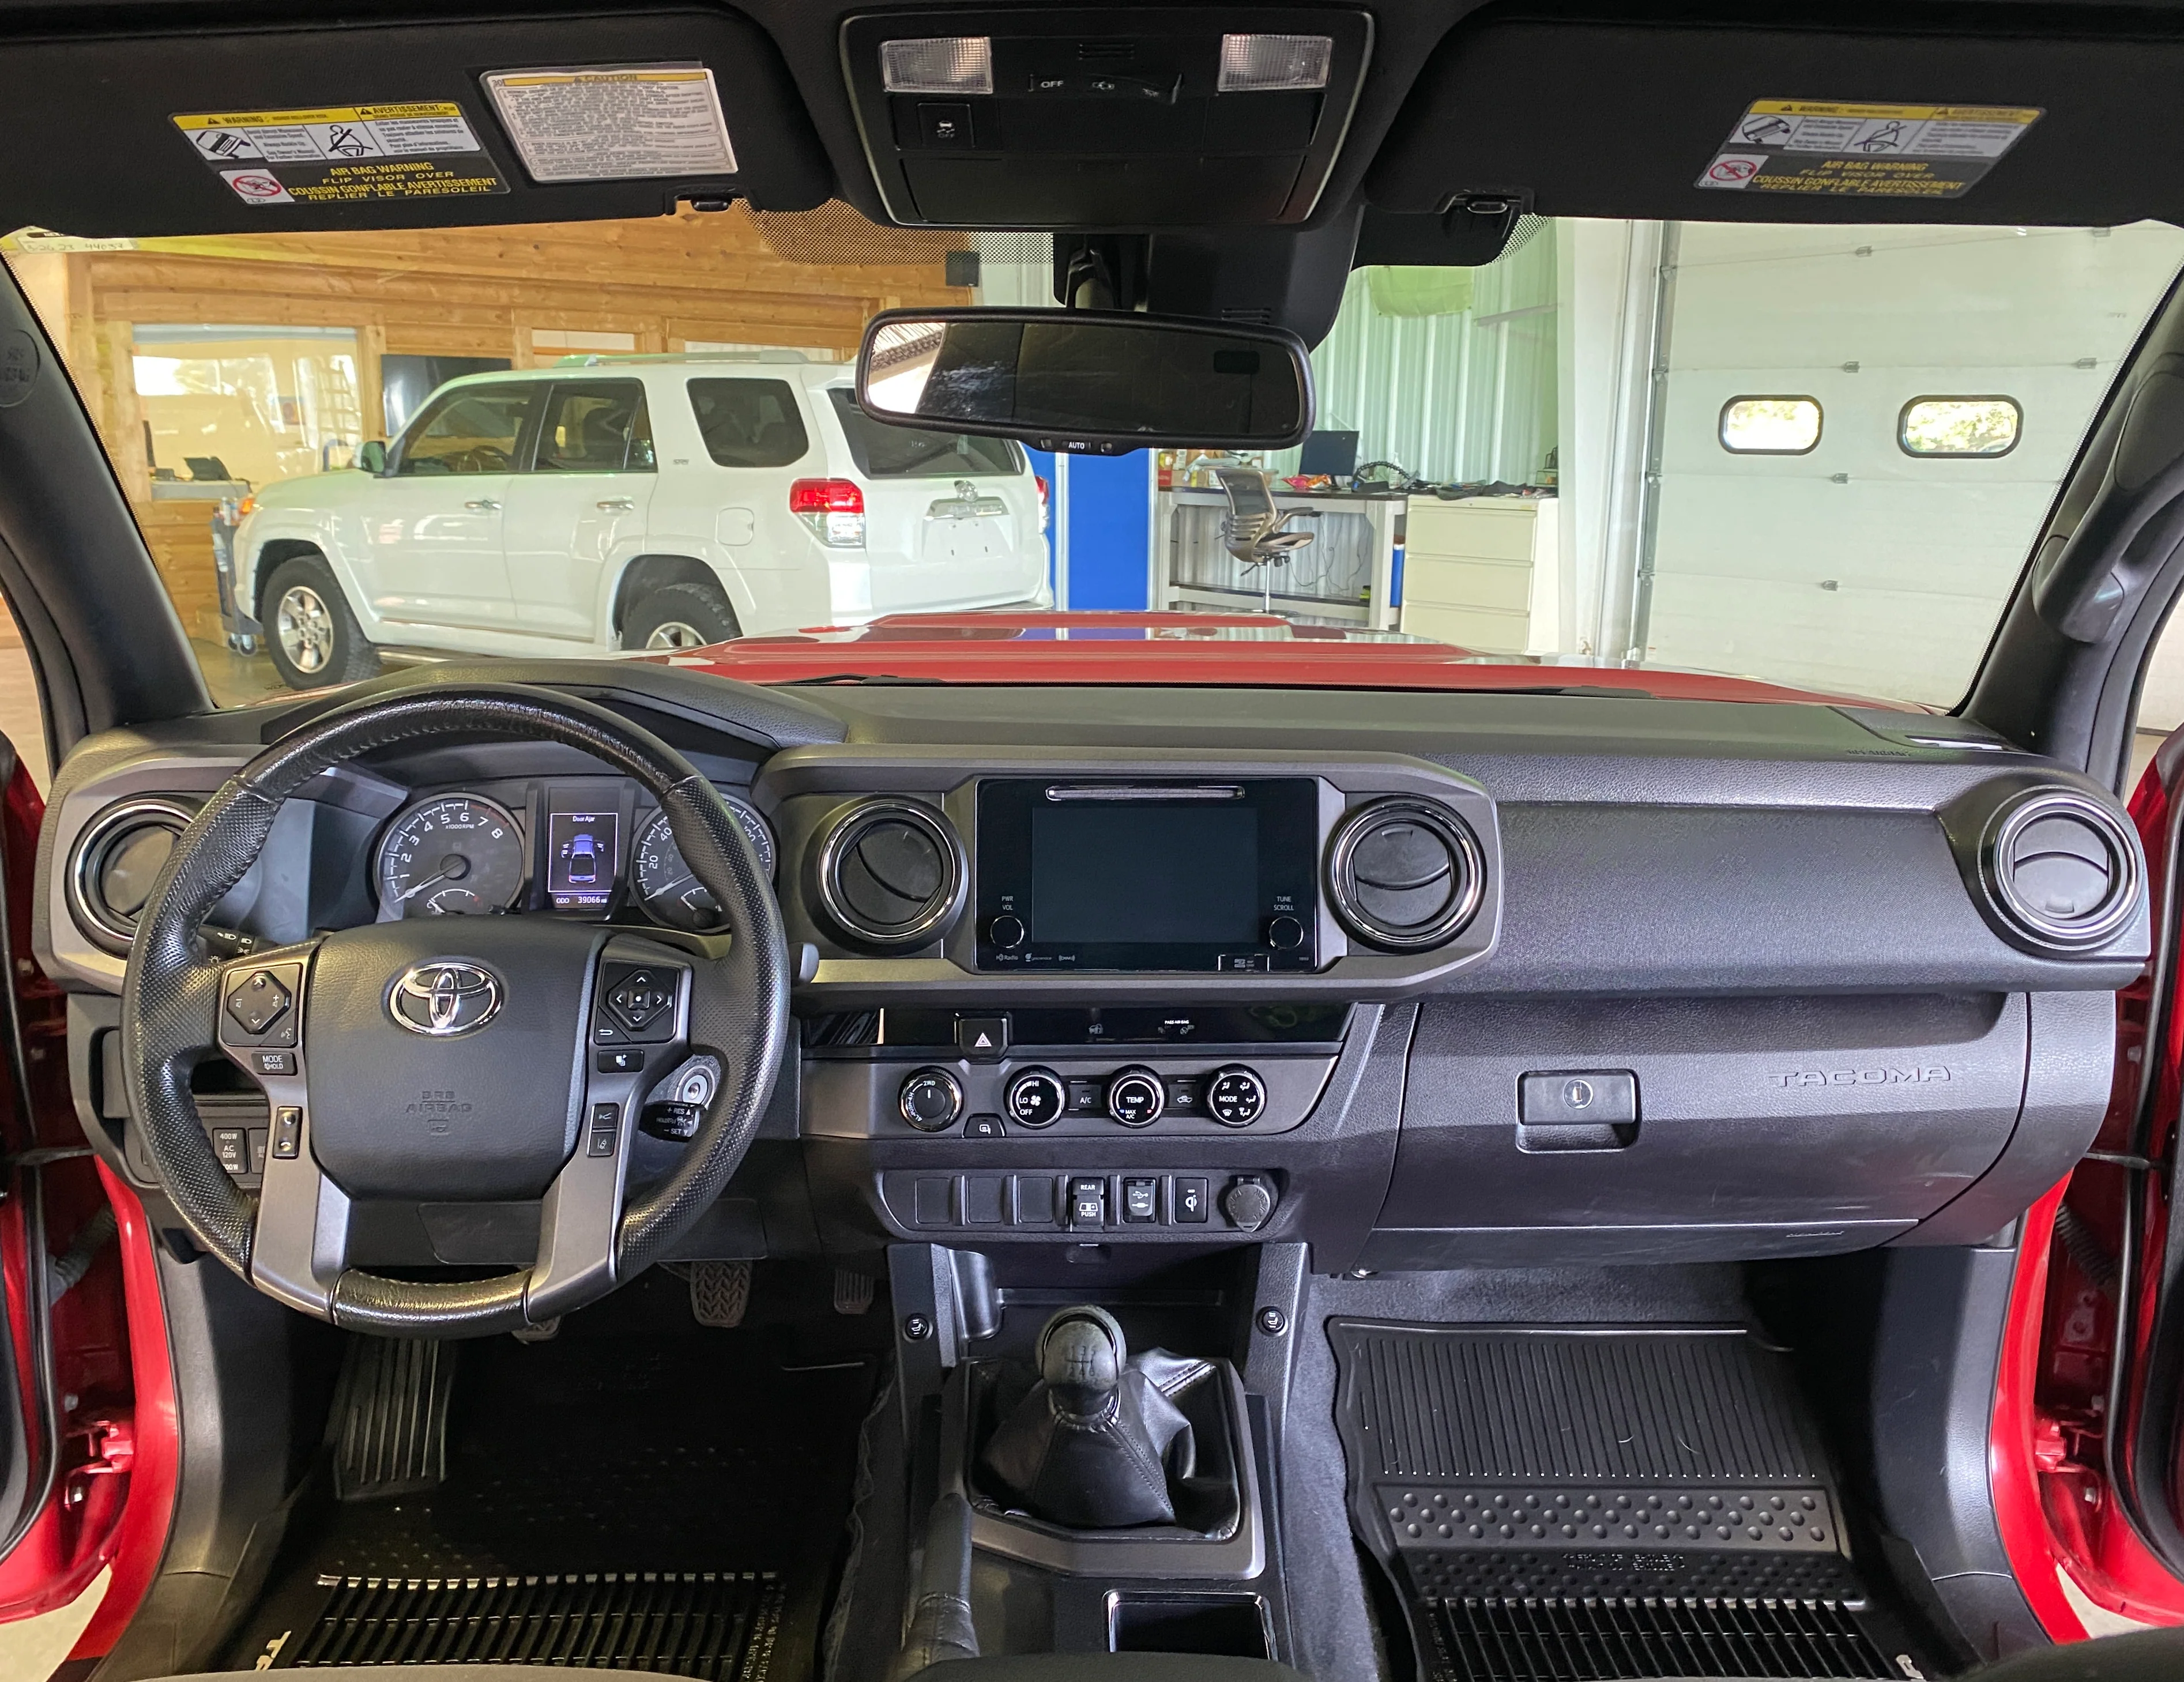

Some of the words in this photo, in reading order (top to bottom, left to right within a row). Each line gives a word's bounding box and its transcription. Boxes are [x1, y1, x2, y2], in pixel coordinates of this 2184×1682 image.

[373, 104, 440, 114] AVERTISSEMENT
[223, 116, 264, 124] WARNING
[330, 168, 351, 176] AIR
[351, 166, 376, 175] BAG
[376, 162, 434, 173] WARNING
[362, 174, 405, 182] VISOR
[288, 186, 339, 195] COUSSIN
[340, 182, 406, 193] GONFLABLE
[407, 178, 496, 190] AVERTISSEMENT
[309, 192, 368, 201] REPLIER
[405, 186, 491, 195] PARESOLEIL
[1068, 442, 1085, 450] AUTO
[440, 813, 450, 824] 5
[460, 812, 469, 822] 6
[477, 816, 488, 826] 7
[424, 821, 433, 832] 4
[491, 828, 503, 839] 8
[660, 827, 672, 841] 40
[409, 835, 419, 846] 3
[401, 853, 412, 862] 2
[649, 855, 658, 869] 20
[578, 896, 600, 904] 39066
[262, 1055, 283, 1063] MODE
[1768, 1065, 1951, 1088] TACOMA
[405, 1103, 472, 1112] AIRBAG
